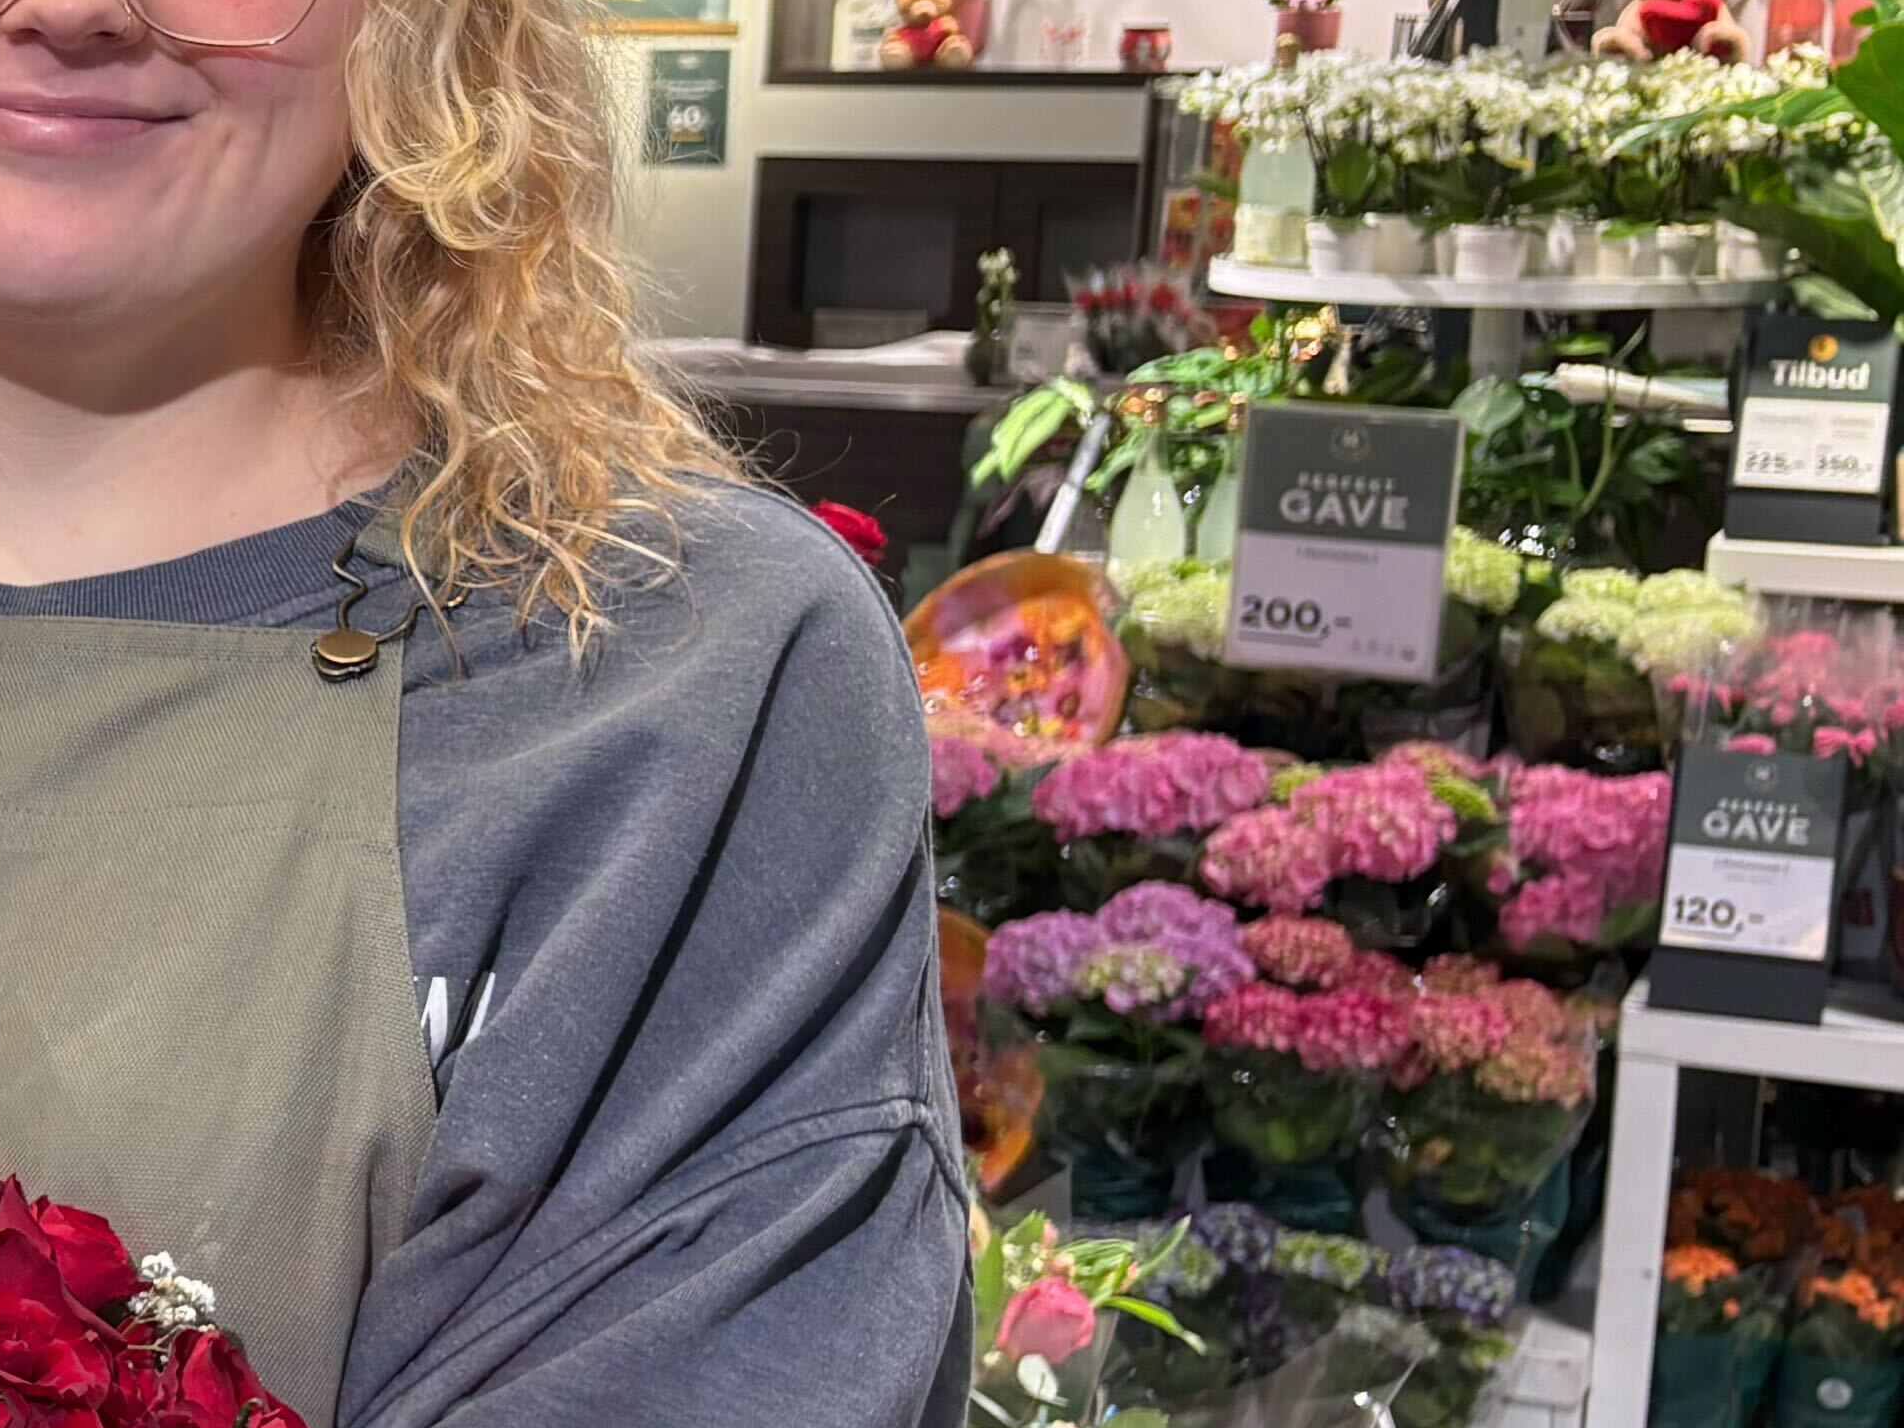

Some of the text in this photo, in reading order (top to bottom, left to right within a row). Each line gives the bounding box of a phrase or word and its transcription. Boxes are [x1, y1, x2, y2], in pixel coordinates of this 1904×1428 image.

[1770, 360, 1871, 390] Tilbud
[1279, 488, 1409, 531] GAVE
[1240, 595, 1352, 639] 200,-
[1702, 809, 1811, 846] GAVE
[1673, 894, 1765, 933] 120,-
